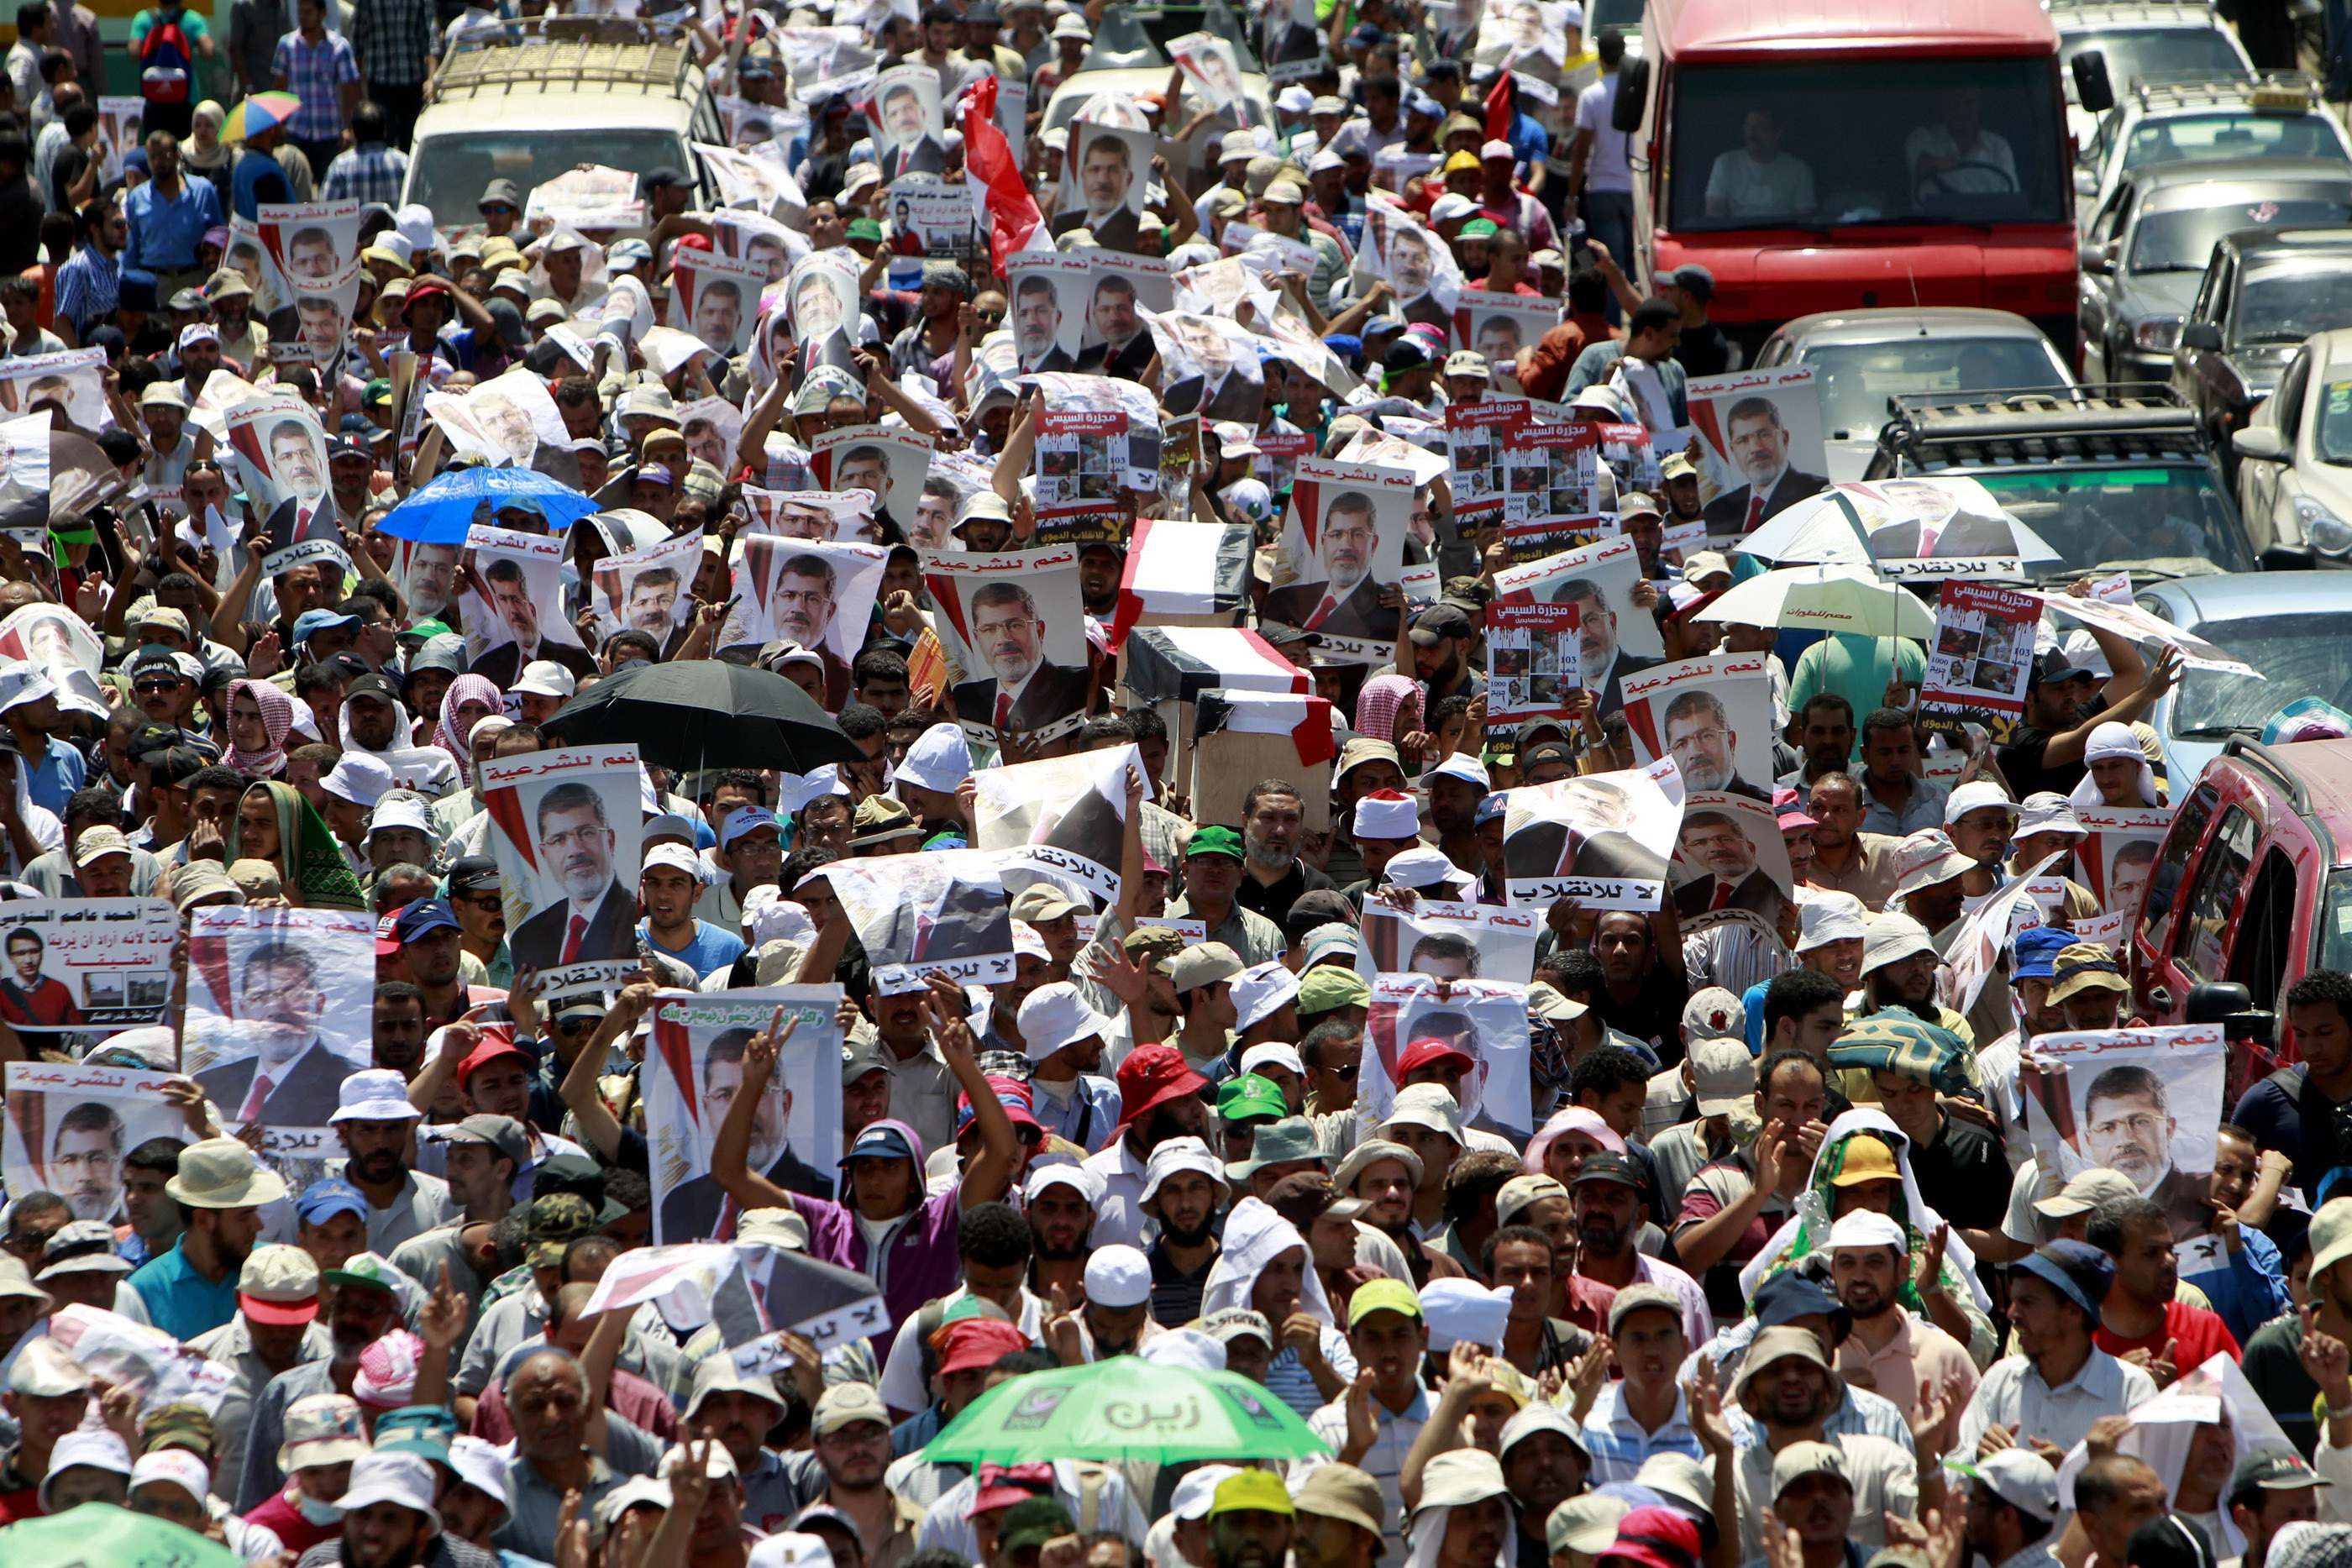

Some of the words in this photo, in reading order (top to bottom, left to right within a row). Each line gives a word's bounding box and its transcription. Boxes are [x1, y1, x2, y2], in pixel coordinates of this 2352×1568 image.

[1062, 260, 1089, 270] نعم
[1689, 375, 1770, 393] للشرعية
[1778, 370, 1813, 384] نعم
[1084, 413, 1116, 423] مجزرة
[816, 428, 891, 447] للشرعية
[1557, 426, 1587, 436] مجزرة
[898, 437, 929, 448] نعم
[1300, 461, 1378, 481] للشرعية
[1383, 472, 1413, 486] نعم
[468, 532, 528, 550] للشرعية
[533, 543, 561, 555] نعم
[266, 539, 344, 570] للانقلاب
[849, 548, 885, 560] نعم
[1033, 551, 1074, 569] نعم
[1597, 542, 1631, 561] نعم
[928, 554, 1024, 571] للشرعية
[1504, 555, 1588, 585] للشرعية
[1882, 561, 1987, 579] للانقلاب
[1998, 560, 2016, 572] لا
[1401, 569, 1436, 585] نعم
[2098, 577, 2127, 600] نعم
[1999, 590, 2034, 607] مجزرة
[1497, 604, 1536, 619] السيسي
[1537, 604, 1568, 616] مجزرة
[1373, 646, 1391, 657] لا
[1560, 656, 1577, 664] 103
[1725, 658, 1762, 677] نعم
[1930, 657, 1949, 667] 1000
[1625, 665, 1714, 695] للشرعية
[1992, 714, 2016, 745] لا
[488, 754, 592, 779] للشرعية
[602, 752, 637, 768] نعم
[1925, 763, 1963, 779] نعم
[1491, 797, 1507, 814] A
[1735, 800, 1772, 815] نعم
[1104, 873, 1117, 891] لا
[2024, 881, 2062, 894] نعم
[1512, 880, 1623, 902] للانقلاب
[1635, 885, 1656, 899] لا
[60, 909, 97, 927] عاصم
[202, 914, 313, 931] للشرعية
[324, 920, 370, 933] نعم
[1488, 913, 1531, 929] نعم
[2018, 916, 2040, 933] نعم
[2099, 915, 2121, 936] نعم
[148, 930, 175, 945] مات
[63, 952, 159, 970] الحقيقة
[990, 958, 1011, 973] لا
[2034, 1030, 2156, 1055] للشرعية
[2168, 1030, 2218, 1049] نعم
[15, 1066, 125, 1088] للشرعية
[2193, 1240, 2218, 1259] لا
[853, 1305, 877, 1326] لا
[1104, 1394, 1200, 1432] زين
